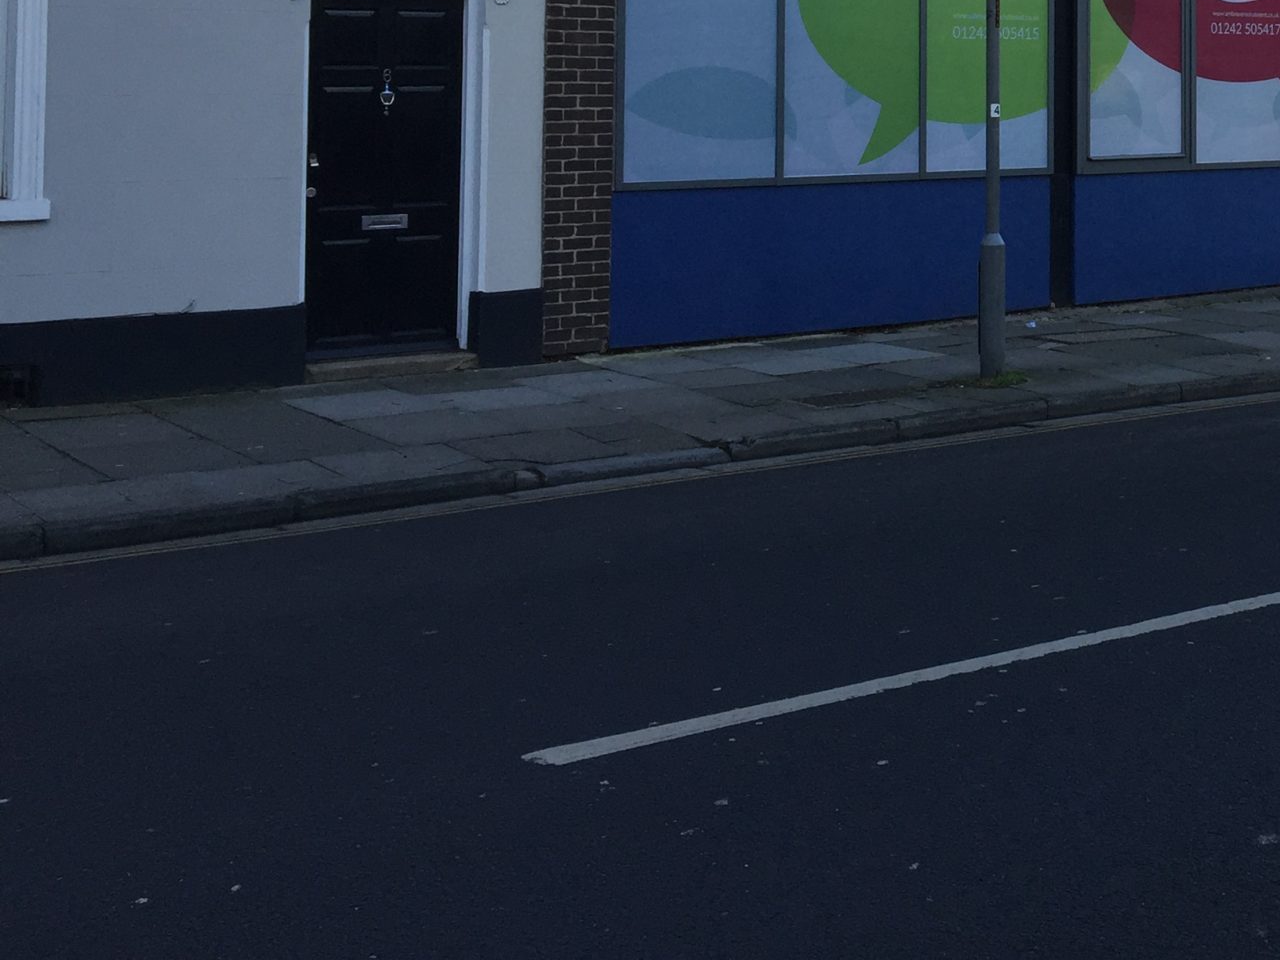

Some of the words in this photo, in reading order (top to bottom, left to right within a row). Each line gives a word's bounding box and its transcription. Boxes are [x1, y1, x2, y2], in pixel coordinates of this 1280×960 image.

[952, 25, 987, 39] 0124
[998, 26, 1040, 40] 05415
[1210, 22, 1242, 34] 01242
[1244, 23, 1280, 35] 505417
[383, 68, 392, 83] 6
